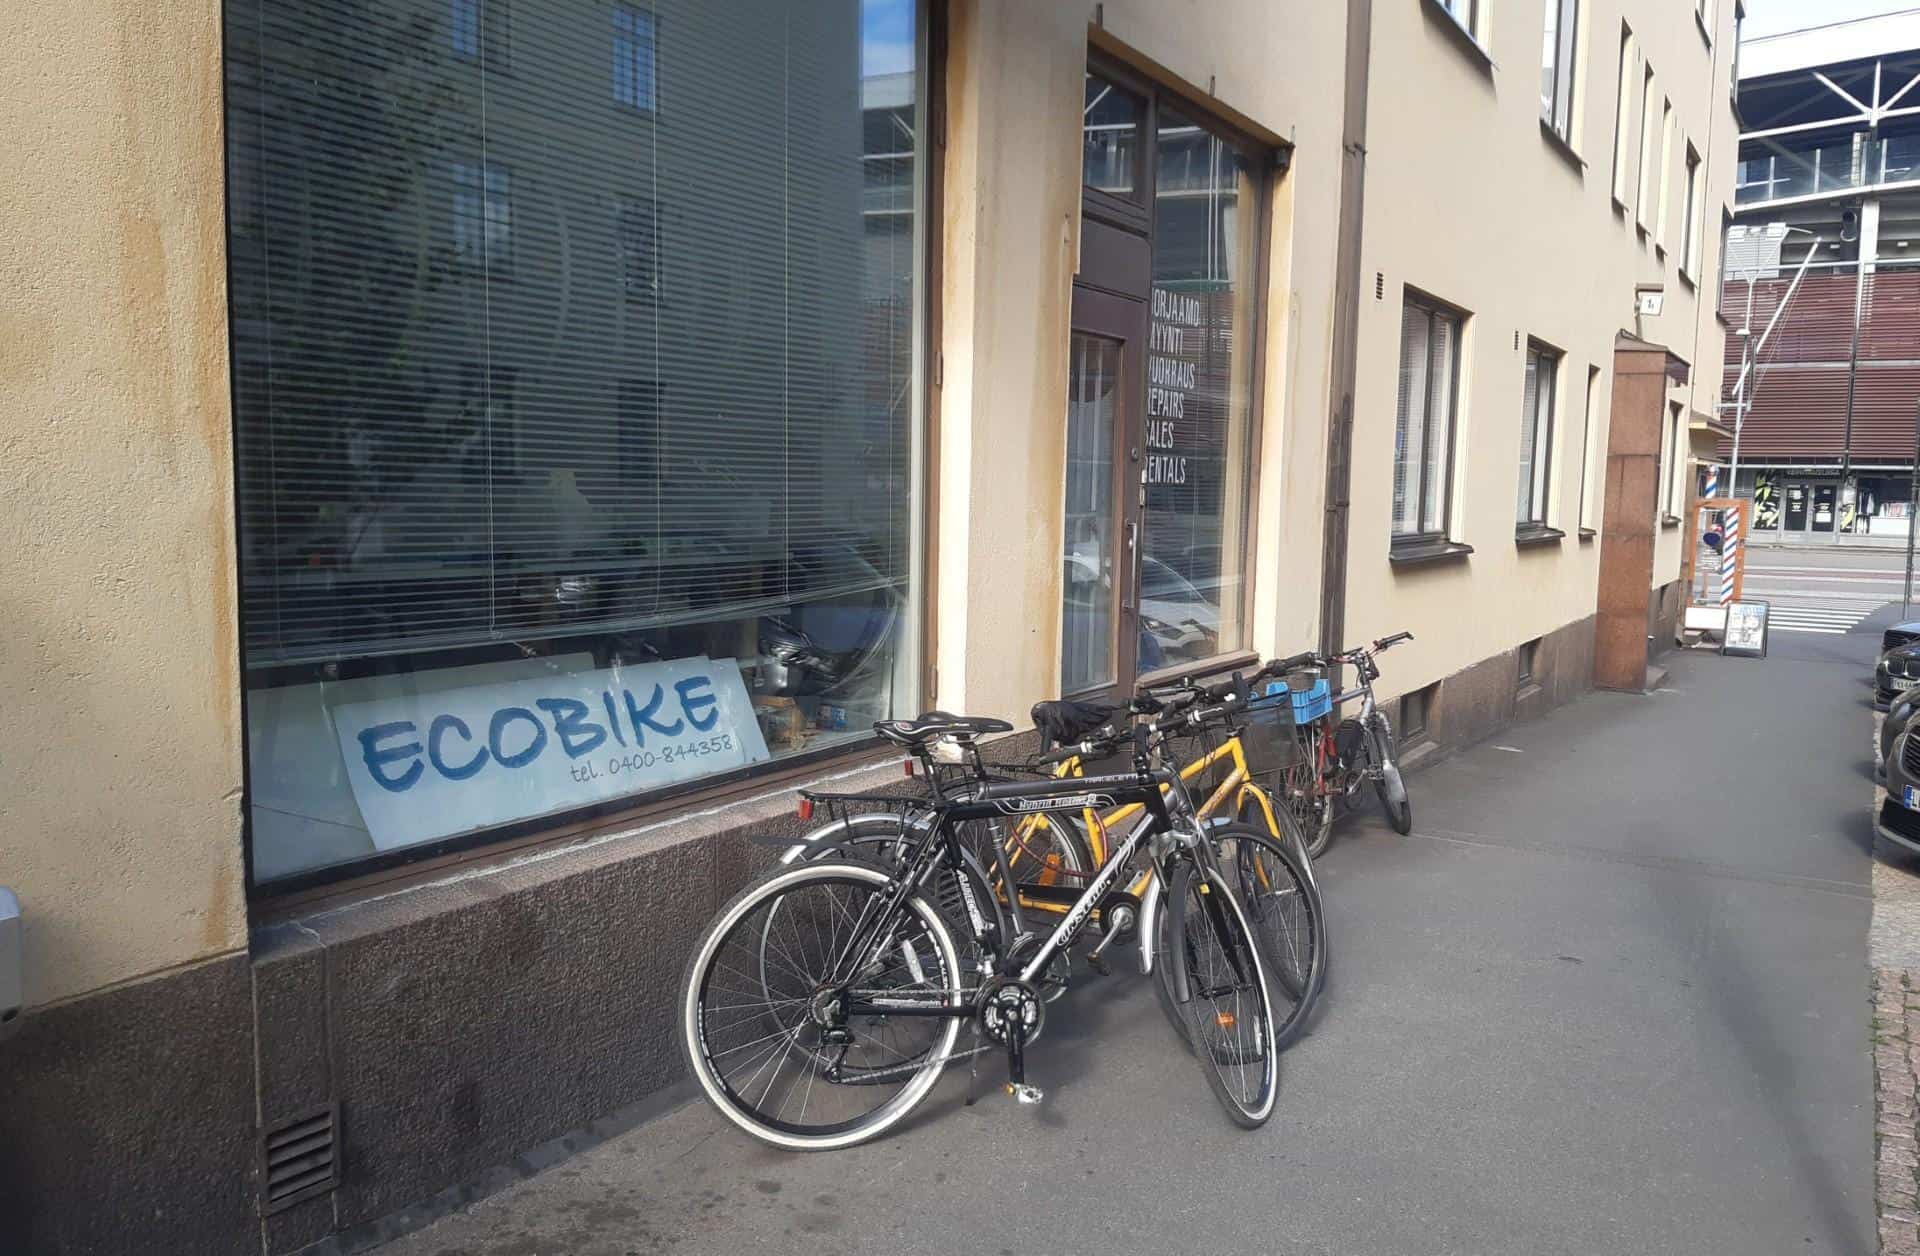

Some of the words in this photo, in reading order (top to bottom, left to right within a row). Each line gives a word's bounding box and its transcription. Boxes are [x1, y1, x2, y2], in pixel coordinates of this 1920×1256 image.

[1152, 288, 1200, 327] ORJAAMO
[358, 675, 721, 793] ECOBIKE
[570, 761, 604, 783] tel.
[609, 735, 734, 776] 0400-844358
